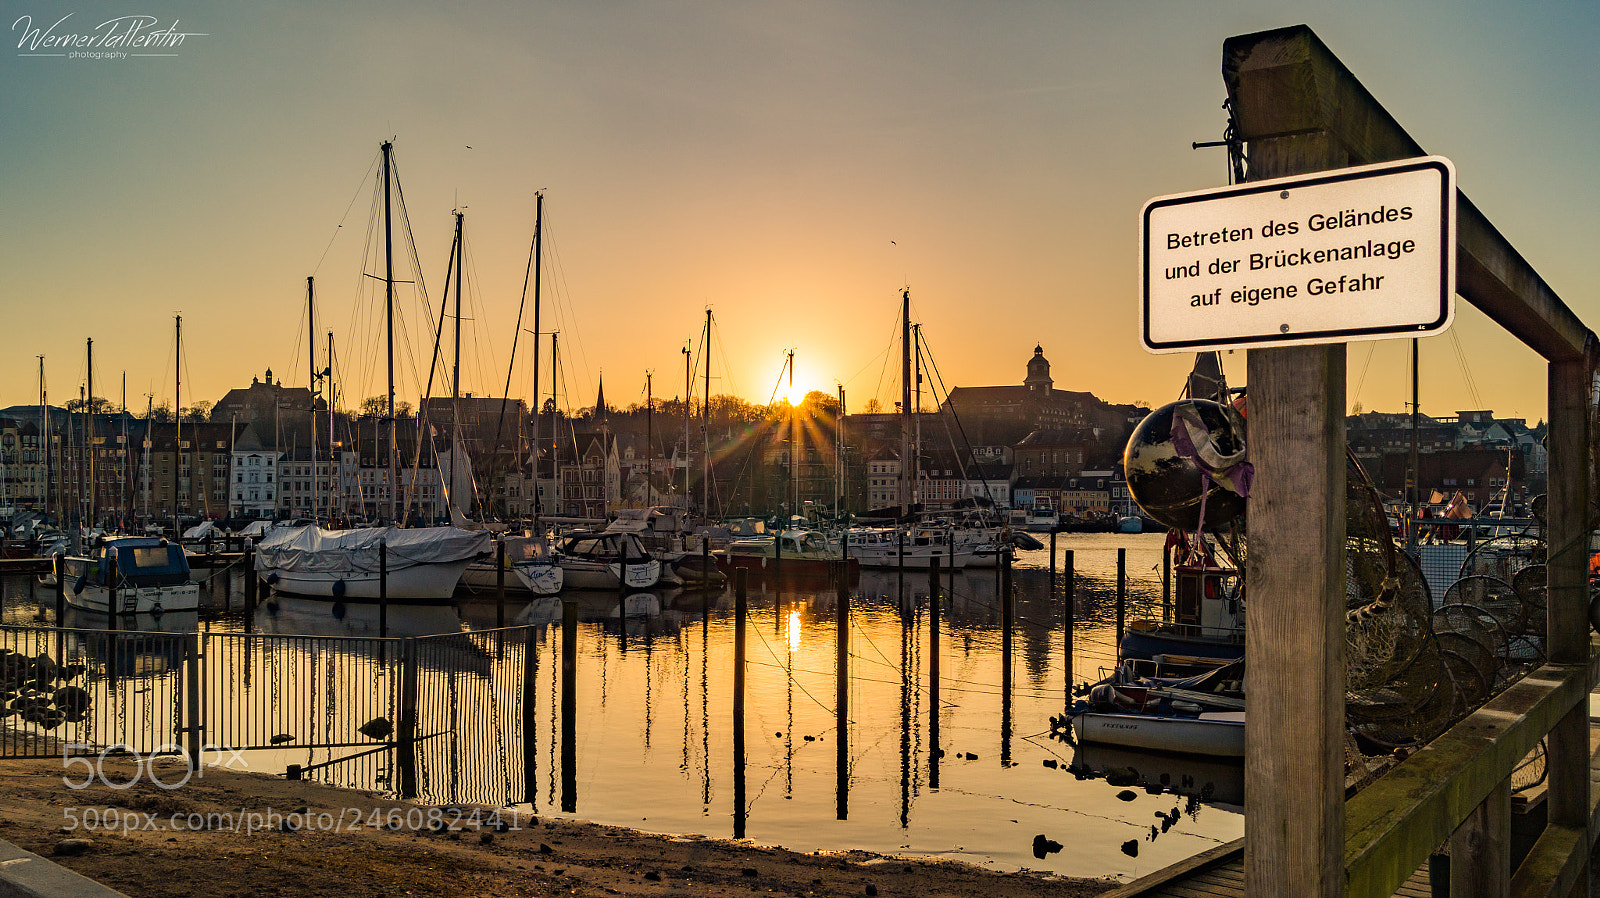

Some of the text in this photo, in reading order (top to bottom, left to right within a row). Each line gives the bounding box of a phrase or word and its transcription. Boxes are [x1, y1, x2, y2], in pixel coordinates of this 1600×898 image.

[1167, 205, 1413, 250] Betreten des Geländes
[1165, 239, 1416, 280] und der Brückenanlage
[1190, 273, 1385, 308] auf eigene Gefahr
